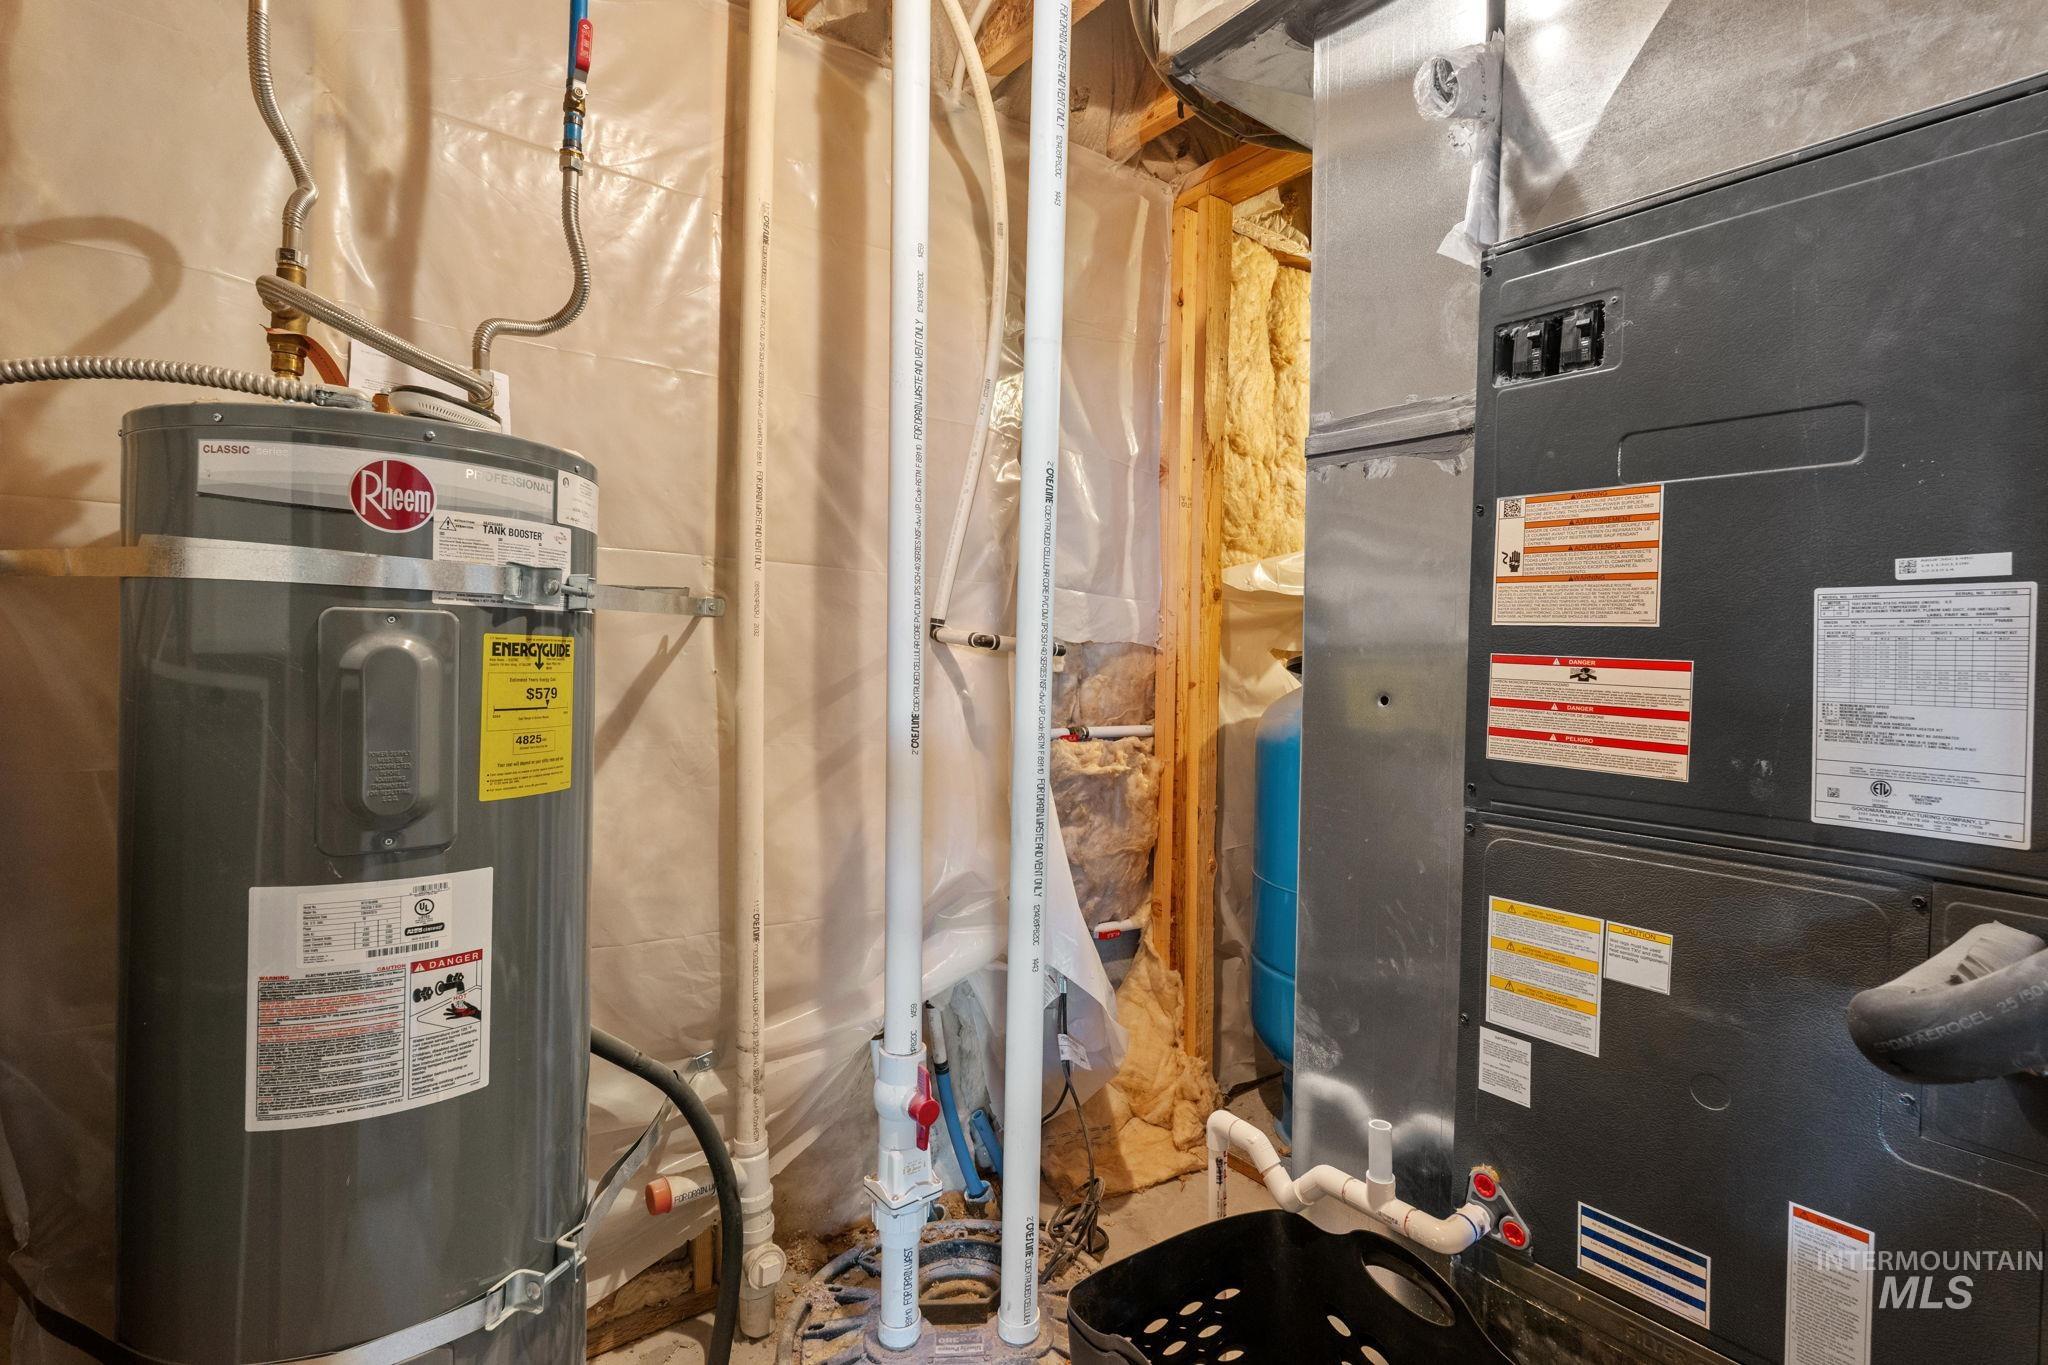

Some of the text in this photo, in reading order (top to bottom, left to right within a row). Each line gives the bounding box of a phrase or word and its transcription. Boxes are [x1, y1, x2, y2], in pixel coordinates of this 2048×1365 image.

[1056, 109, 1065, 129] ONLY
[915, 319, 924, 339] ONLY
[914, 340, 924, 359] VENT
[914, 360, 924, 376] AND
[914, 376, 923, 401] WASTE
[914, 402, 923, 425] DRAIN
[914, 424, 922, 440] FOR
[203, 444, 250, 455] CLASSIC
[466, 468, 552, 494] PROFESSIONAL
[360, 460, 431, 520] Rheem
[1576, 491, 1608, 499] WARNING
[1044, 505, 1052, 546] COEXTRUDED
[1576, 516, 1631, 525] AVERTISSEMENT
[483, 525, 543, 541] TANK BOOSTER
[1574, 543, 1621, 551] ADVERTENCIA
[1042, 546, 1051, 577] CELLULAR
[1042, 578, 1050, 594] CORE
[1042, 596, 1050, 608] PVC
[913, 624, 921, 640] CORE
[492, 642, 571, 657] ENERGYGUIDE
[913, 641, 921, 671] CELLULAR
[526, 687, 558, 701] $579
[912, 672, 921, 712] COEXTRUDED
[516, 734, 542, 745] 4825
[1036, 778, 1045, 793] FOR
[1036, 794, 1045, 817] DRAIN
[1851, 806, 1884, 814] GOODMAN
[1885, 808, 1942, 820] MANUFACTURING
[1035, 818, 1044, 843] WASTE
[1034, 843, 1044, 858] AND
[1034, 859, 1043, 877] VENT
[1033, 878, 1042, 897] ONLY
[1622, 927, 1656, 940] CAUTION
[377, 964, 406, 972] CAUTION
[429, 952, 480, 969] DANGER
[453, 993, 467, 1001] HOT
[1914, 1010, 1993, 1045] AEROCEL
[903, 1268, 913, 1291] DRAIN
[1024, 1258, 1032, 1298] COEXTRUDED
[903, 1291, 912, 1305] FOR
